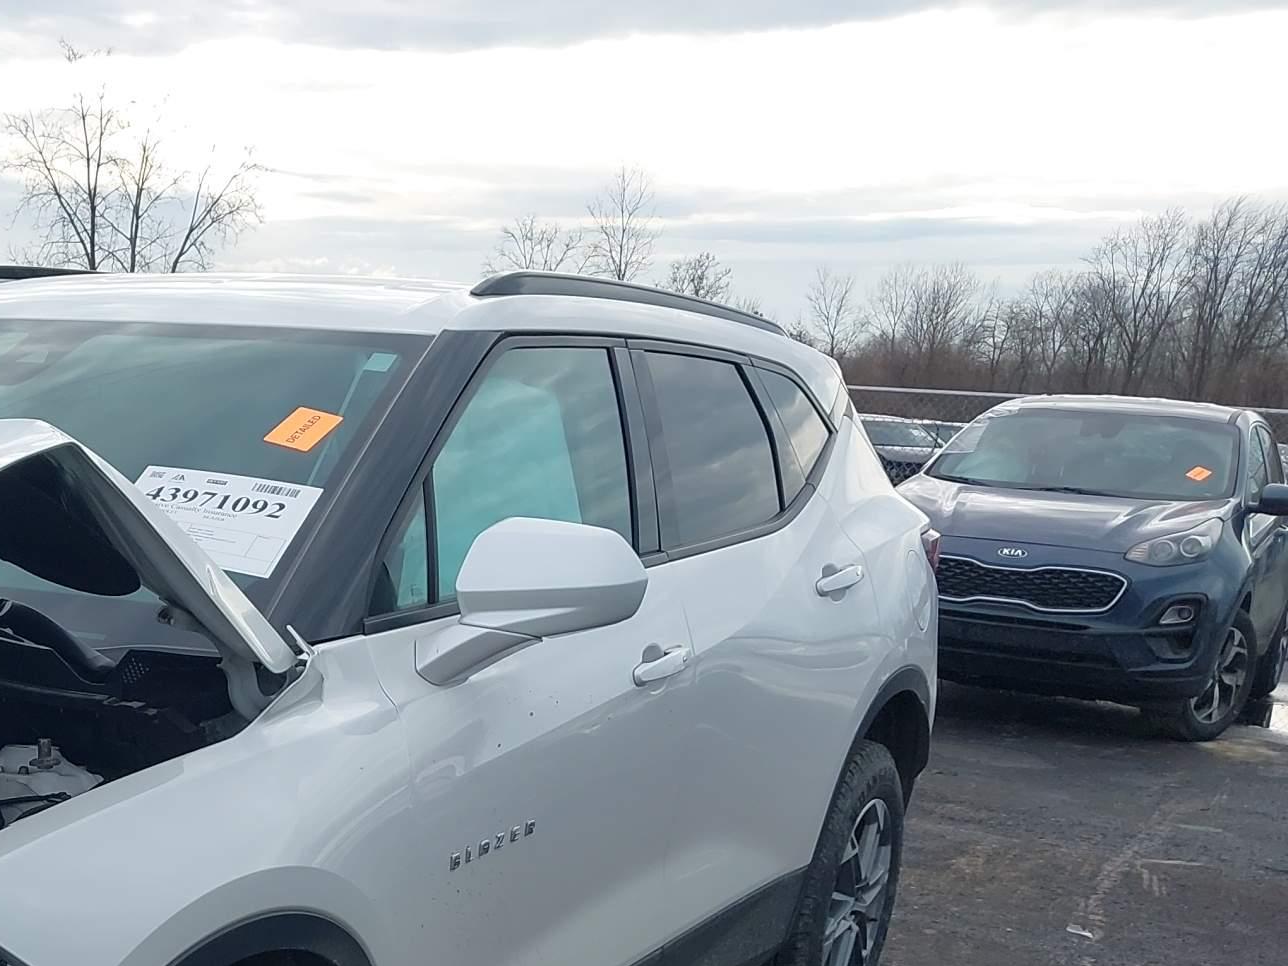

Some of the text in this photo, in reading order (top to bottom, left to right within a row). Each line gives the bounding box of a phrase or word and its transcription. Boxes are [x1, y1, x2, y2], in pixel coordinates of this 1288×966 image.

[286, 415, 321, 444] DETAILED
[145, 485, 287, 519] 43971092
[1002, 547, 1023, 557] KIA
[450, 819, 536, 872] BLAZER
